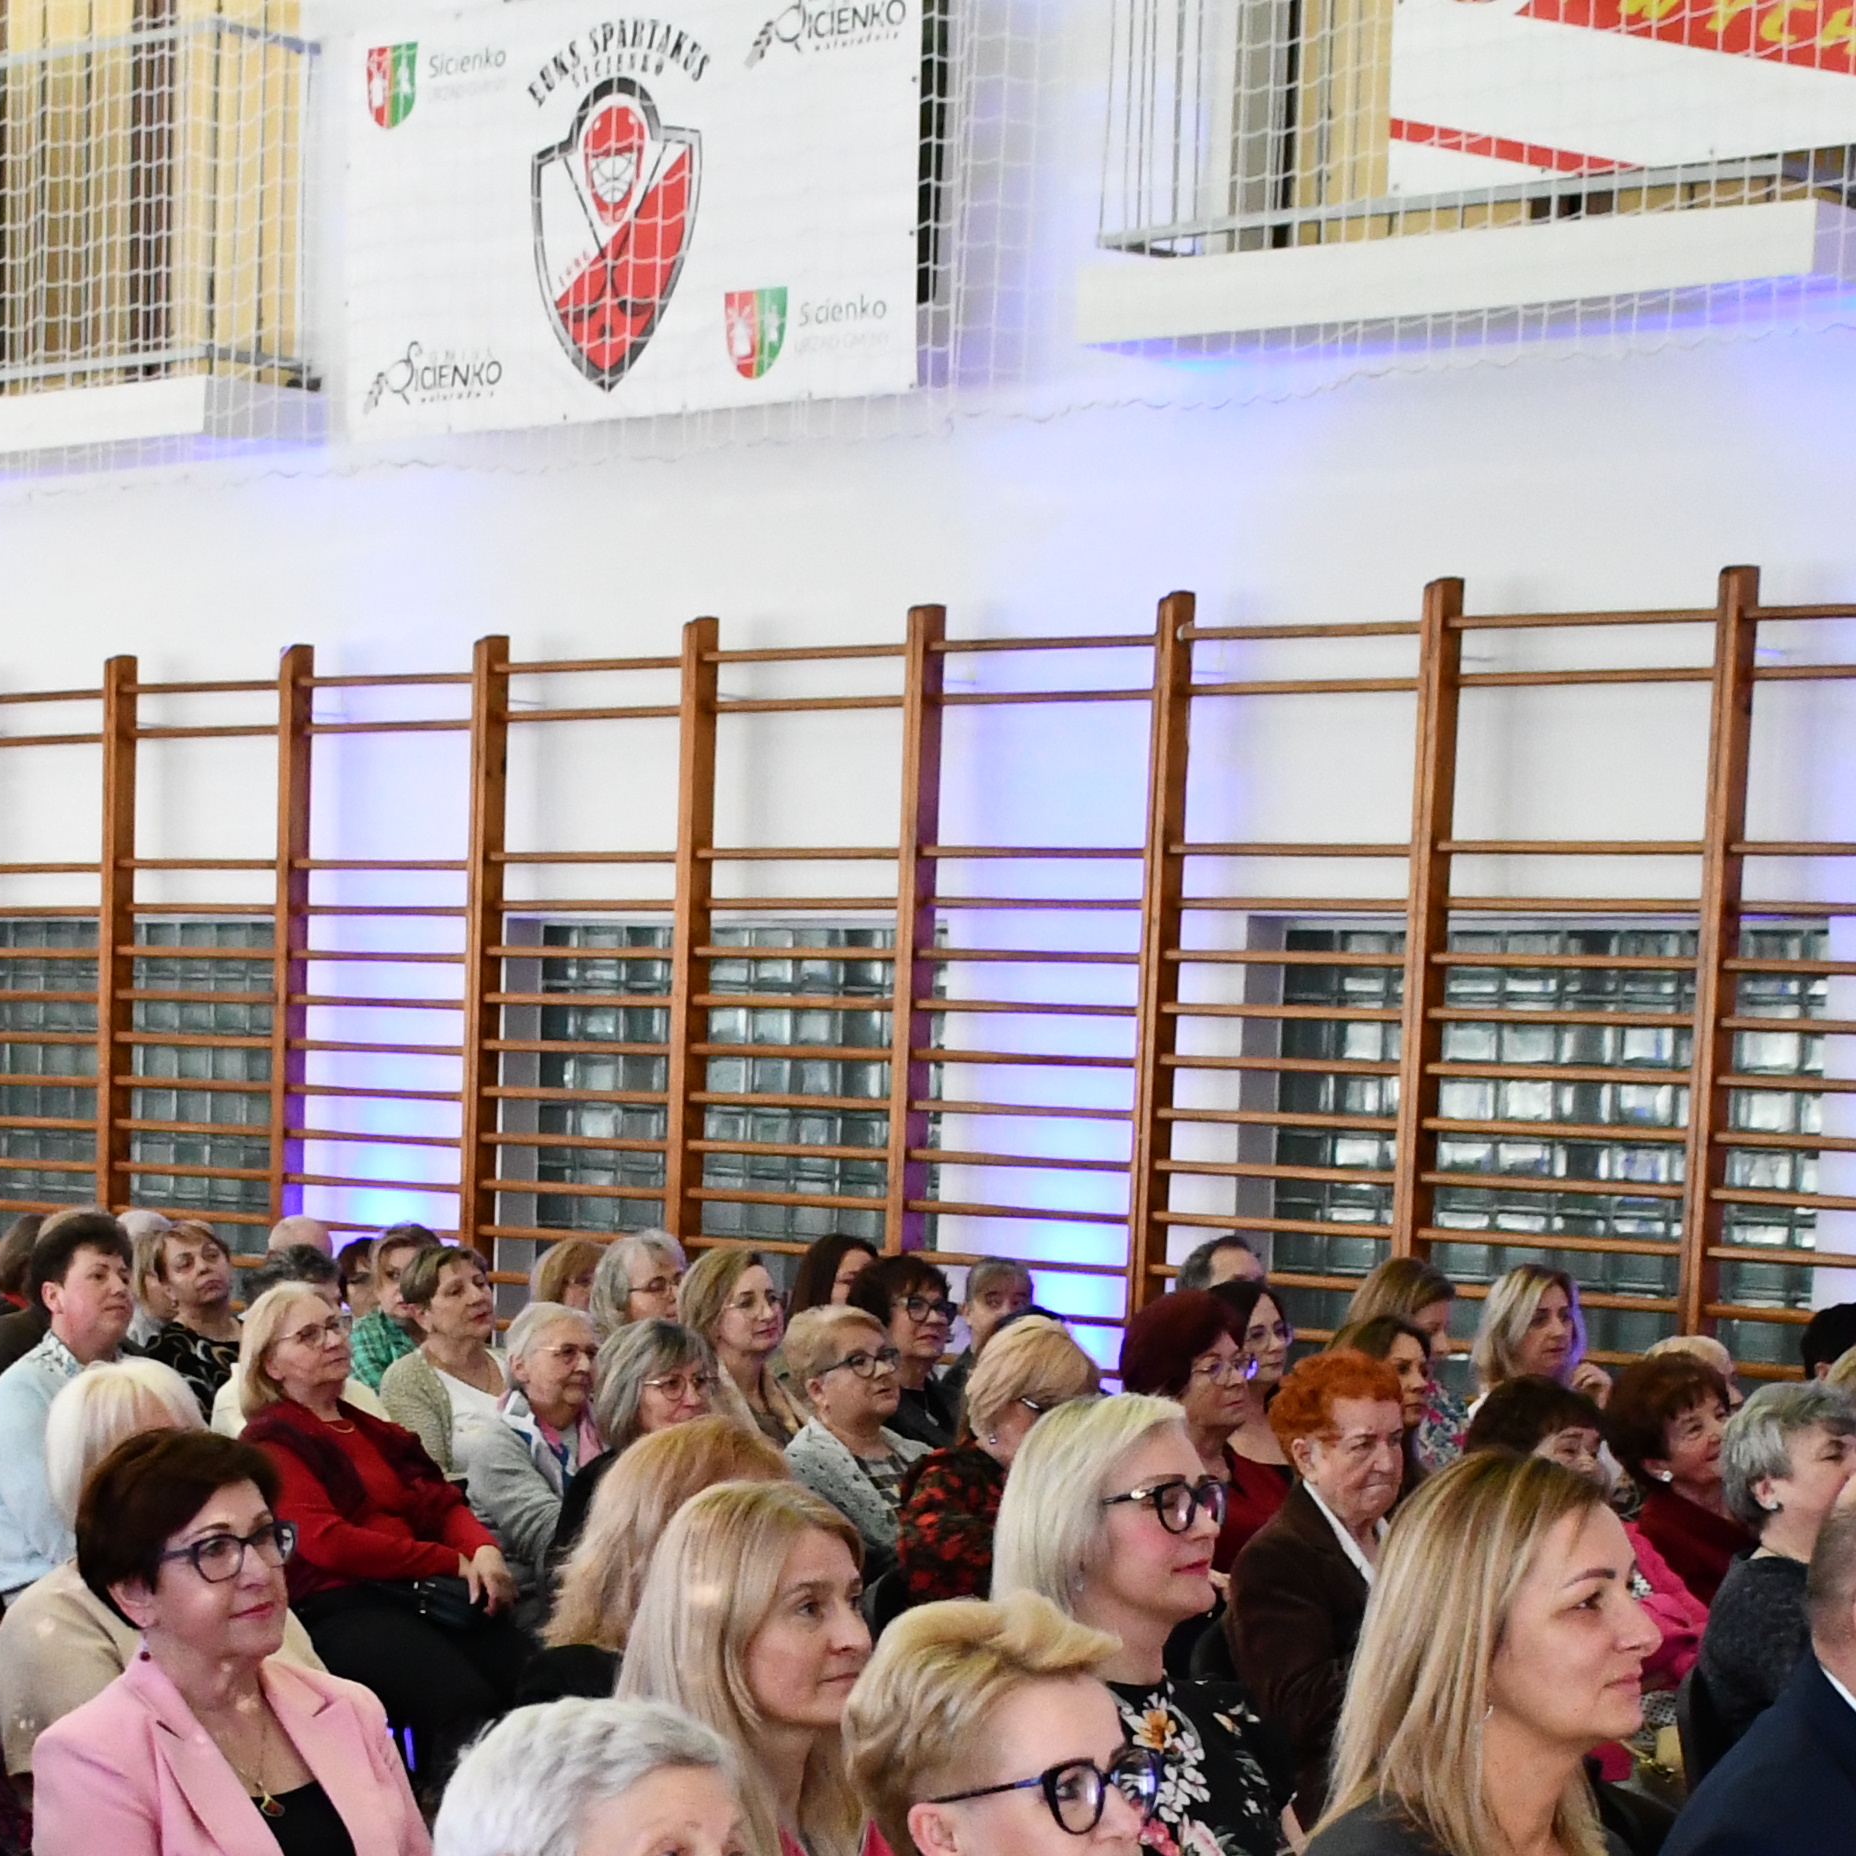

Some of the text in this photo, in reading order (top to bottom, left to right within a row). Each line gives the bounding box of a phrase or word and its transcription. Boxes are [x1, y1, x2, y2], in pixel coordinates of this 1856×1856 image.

[429, 47, 506, 78] Sicienko
[589, 17, 711, 82] SPARTAKUS
[799, 294, 887, 327] Scienko
